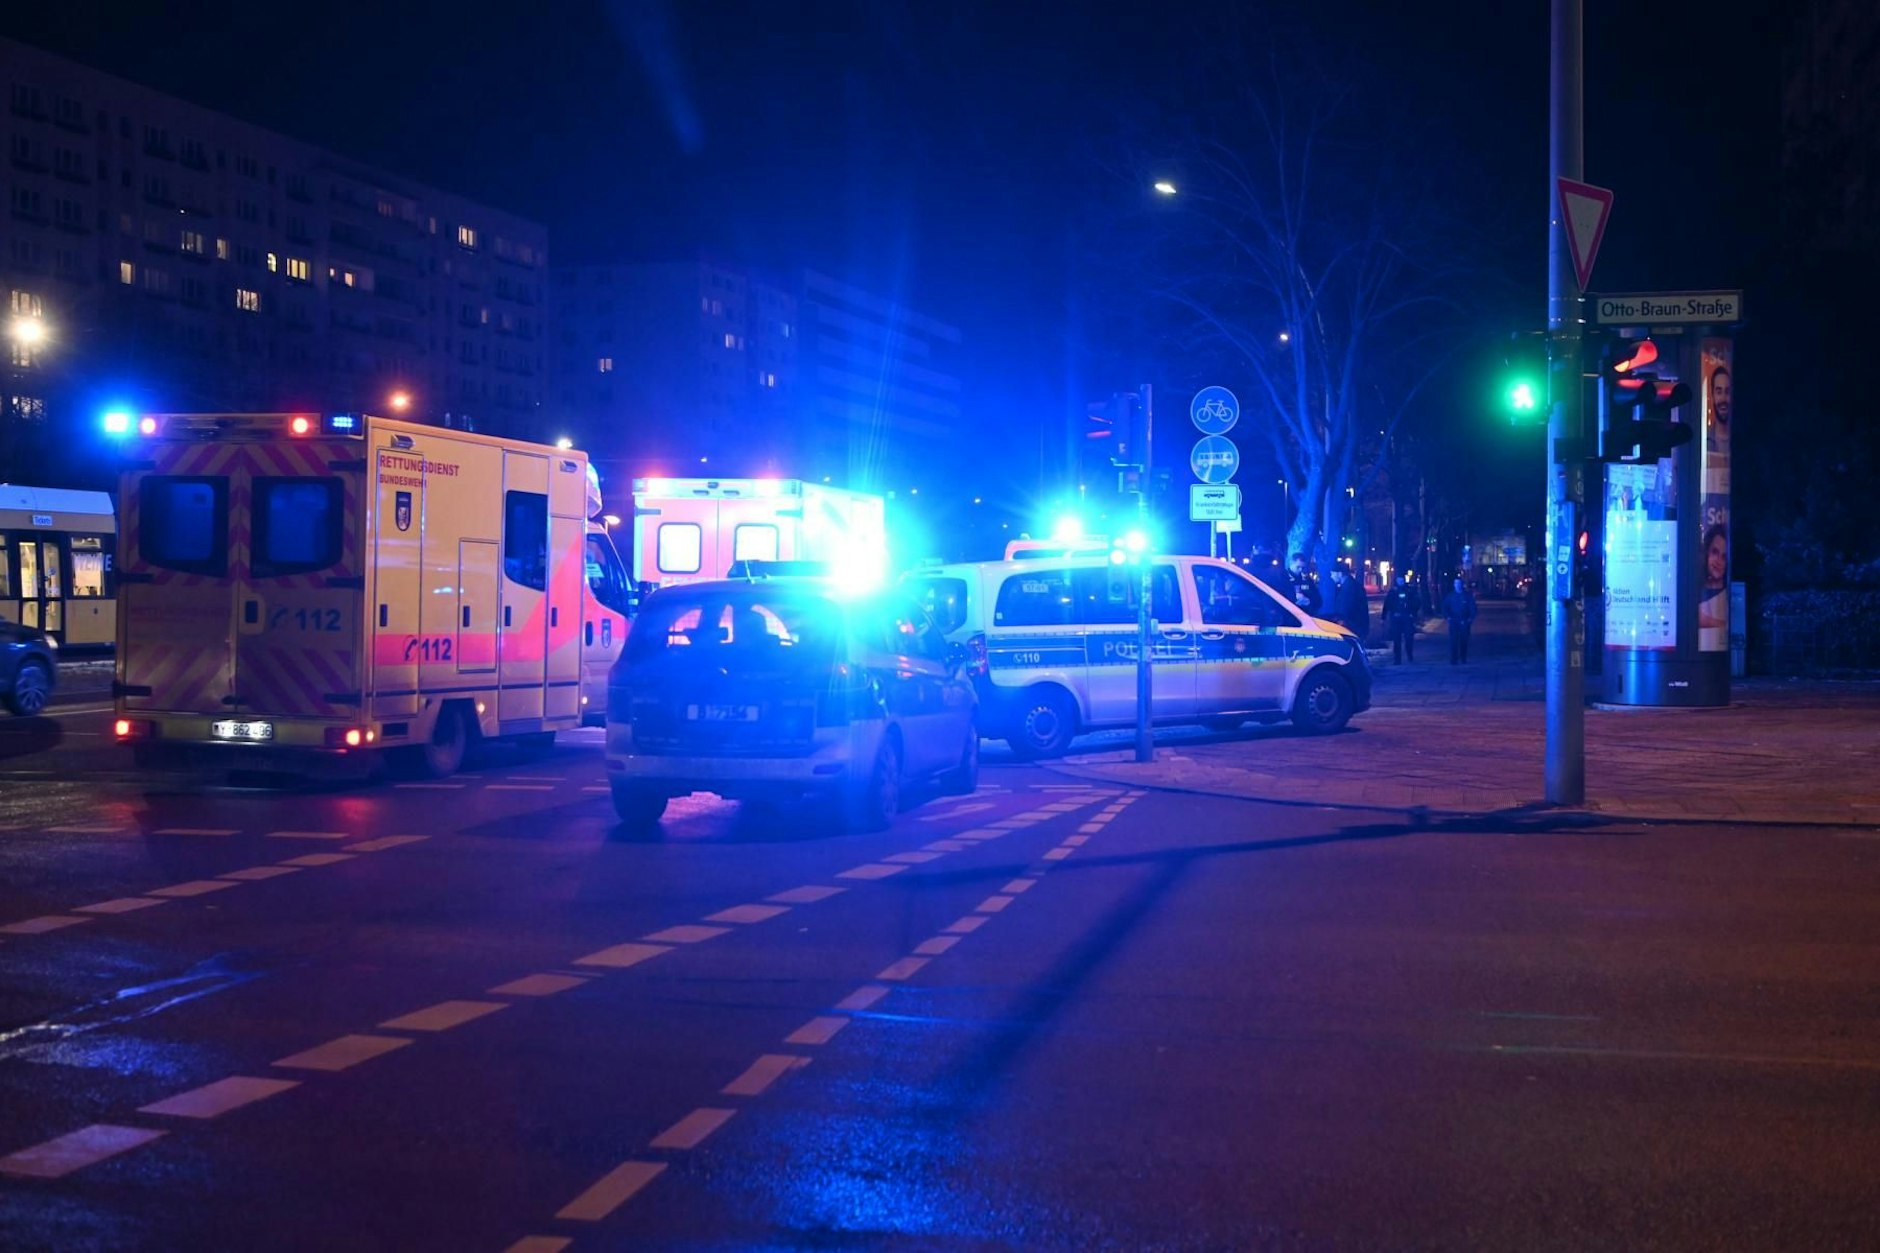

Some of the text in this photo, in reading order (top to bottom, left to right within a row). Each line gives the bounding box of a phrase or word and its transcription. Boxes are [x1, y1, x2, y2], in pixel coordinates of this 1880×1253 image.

[1601, 299, 1733, 318] Otto-Braun-Straße
[380, 455, 460, 477] RETTUNGSDIENST
[1652, 595, 1670, 603] Hlft
[295, 608, 342, 632] 112
[421, 638, 452, 661] 112
[1023, 652, 1041, 664] 110
[1104, 640, 1172, 658] POLEI
[233, 724, 251, 736] 862
